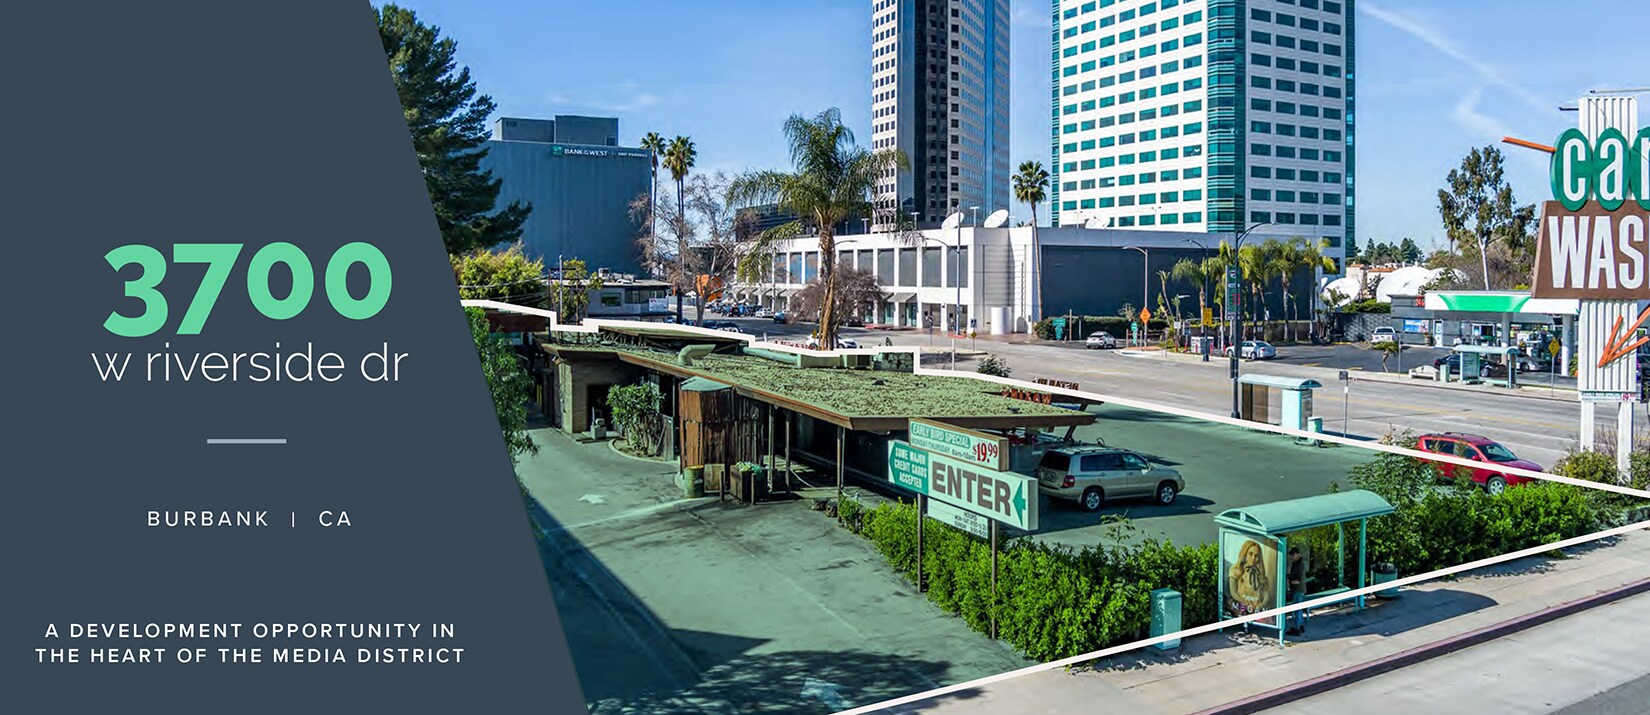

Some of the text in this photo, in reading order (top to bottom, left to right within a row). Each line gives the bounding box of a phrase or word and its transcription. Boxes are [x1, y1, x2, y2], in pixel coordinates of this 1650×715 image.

[1548, 214, 1650, 289] WAS
[944, 431, 969, 448] SPECIAL
[894, 458, 927, 478] CREDIT CARDS
[899, 471, 923, 489] ACCEPTED
[932, 461, 1011, 517] ENTER
